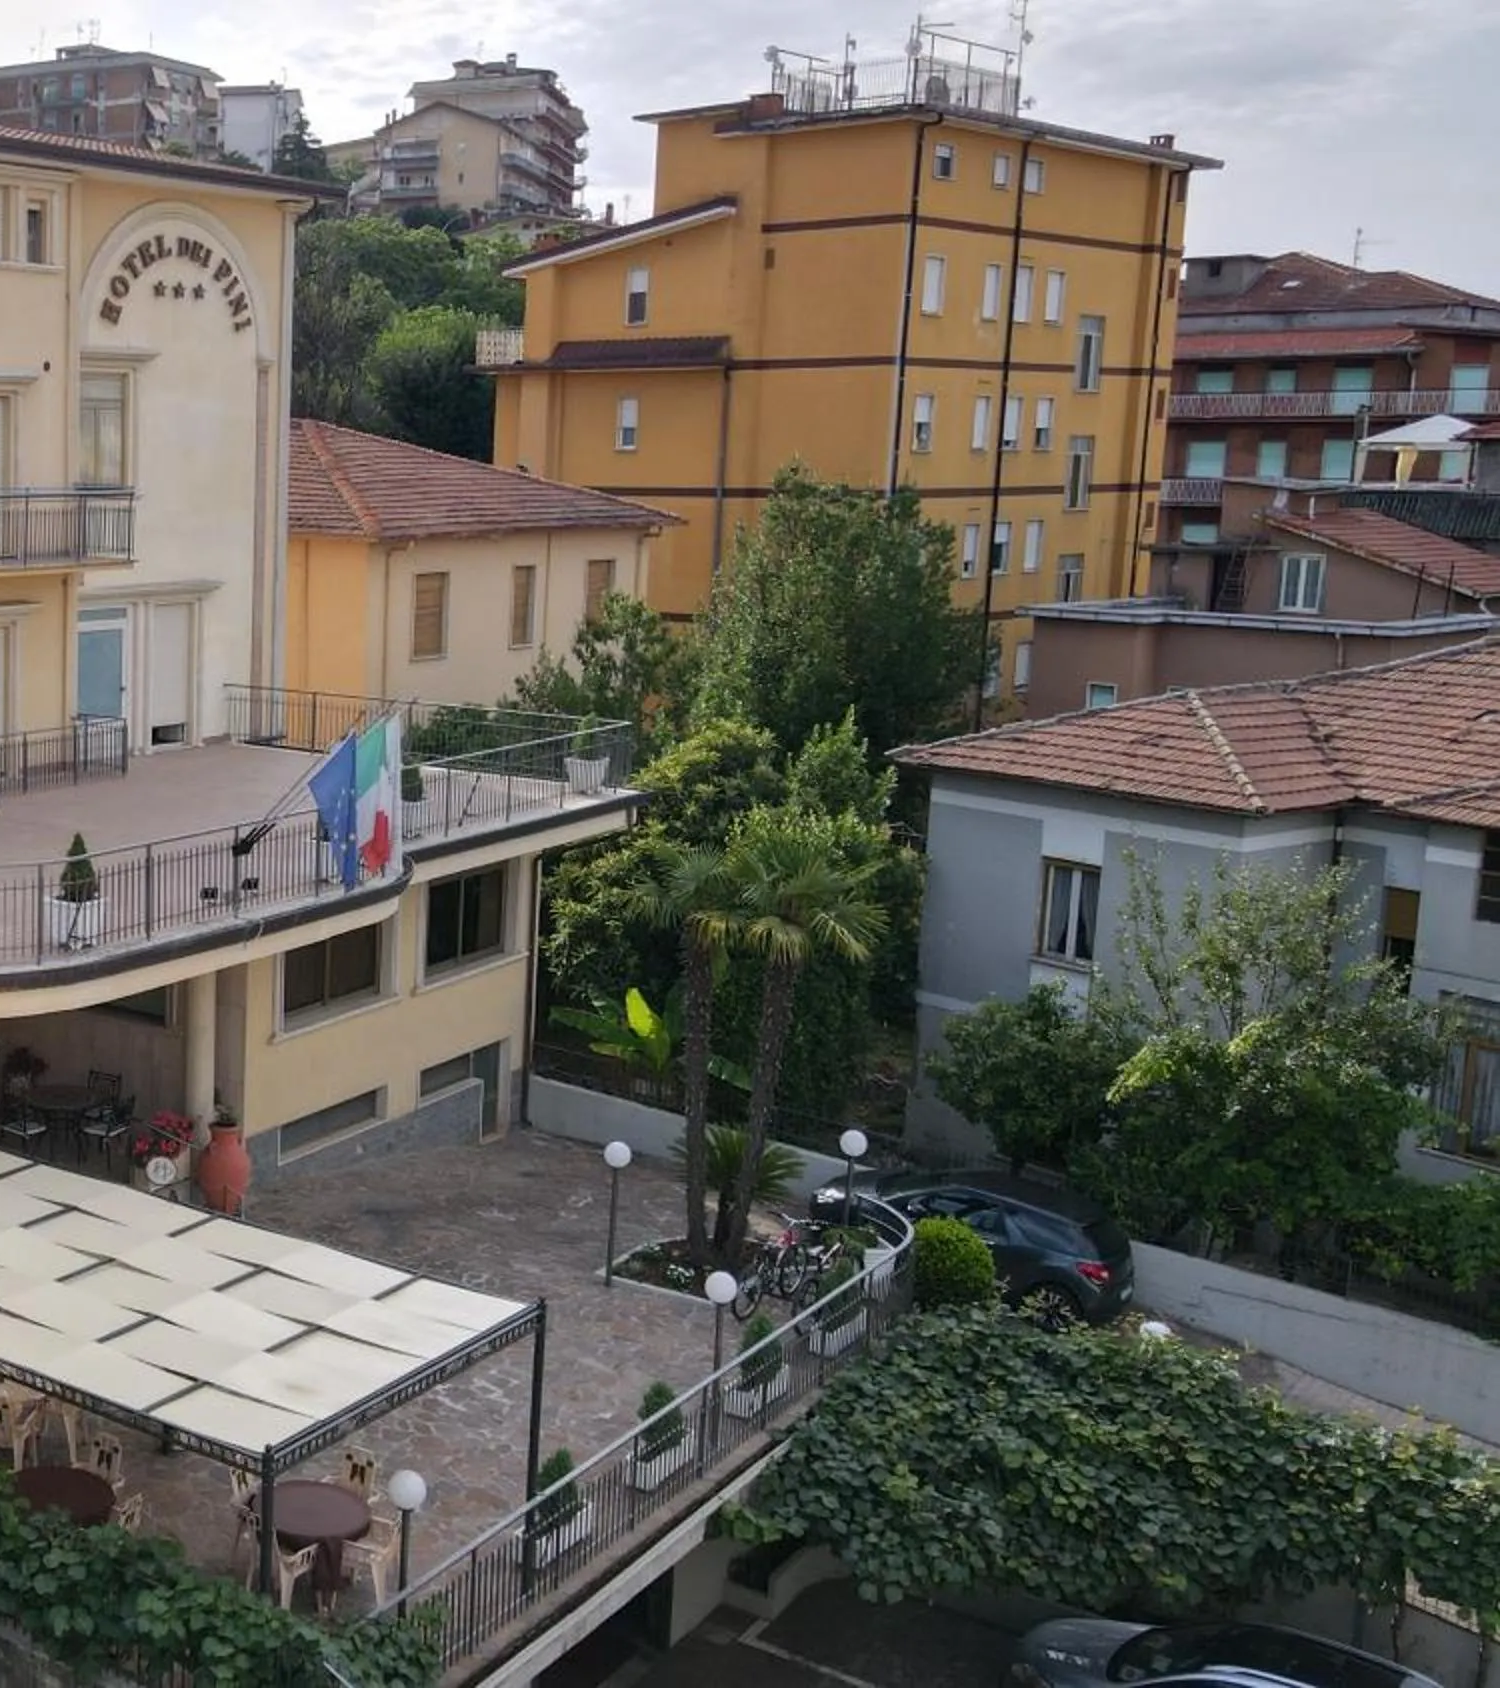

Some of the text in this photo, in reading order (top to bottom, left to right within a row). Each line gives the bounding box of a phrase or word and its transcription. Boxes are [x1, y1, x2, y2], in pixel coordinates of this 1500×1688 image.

[100, 235, 252, 333] HOTEL DEI PINI
